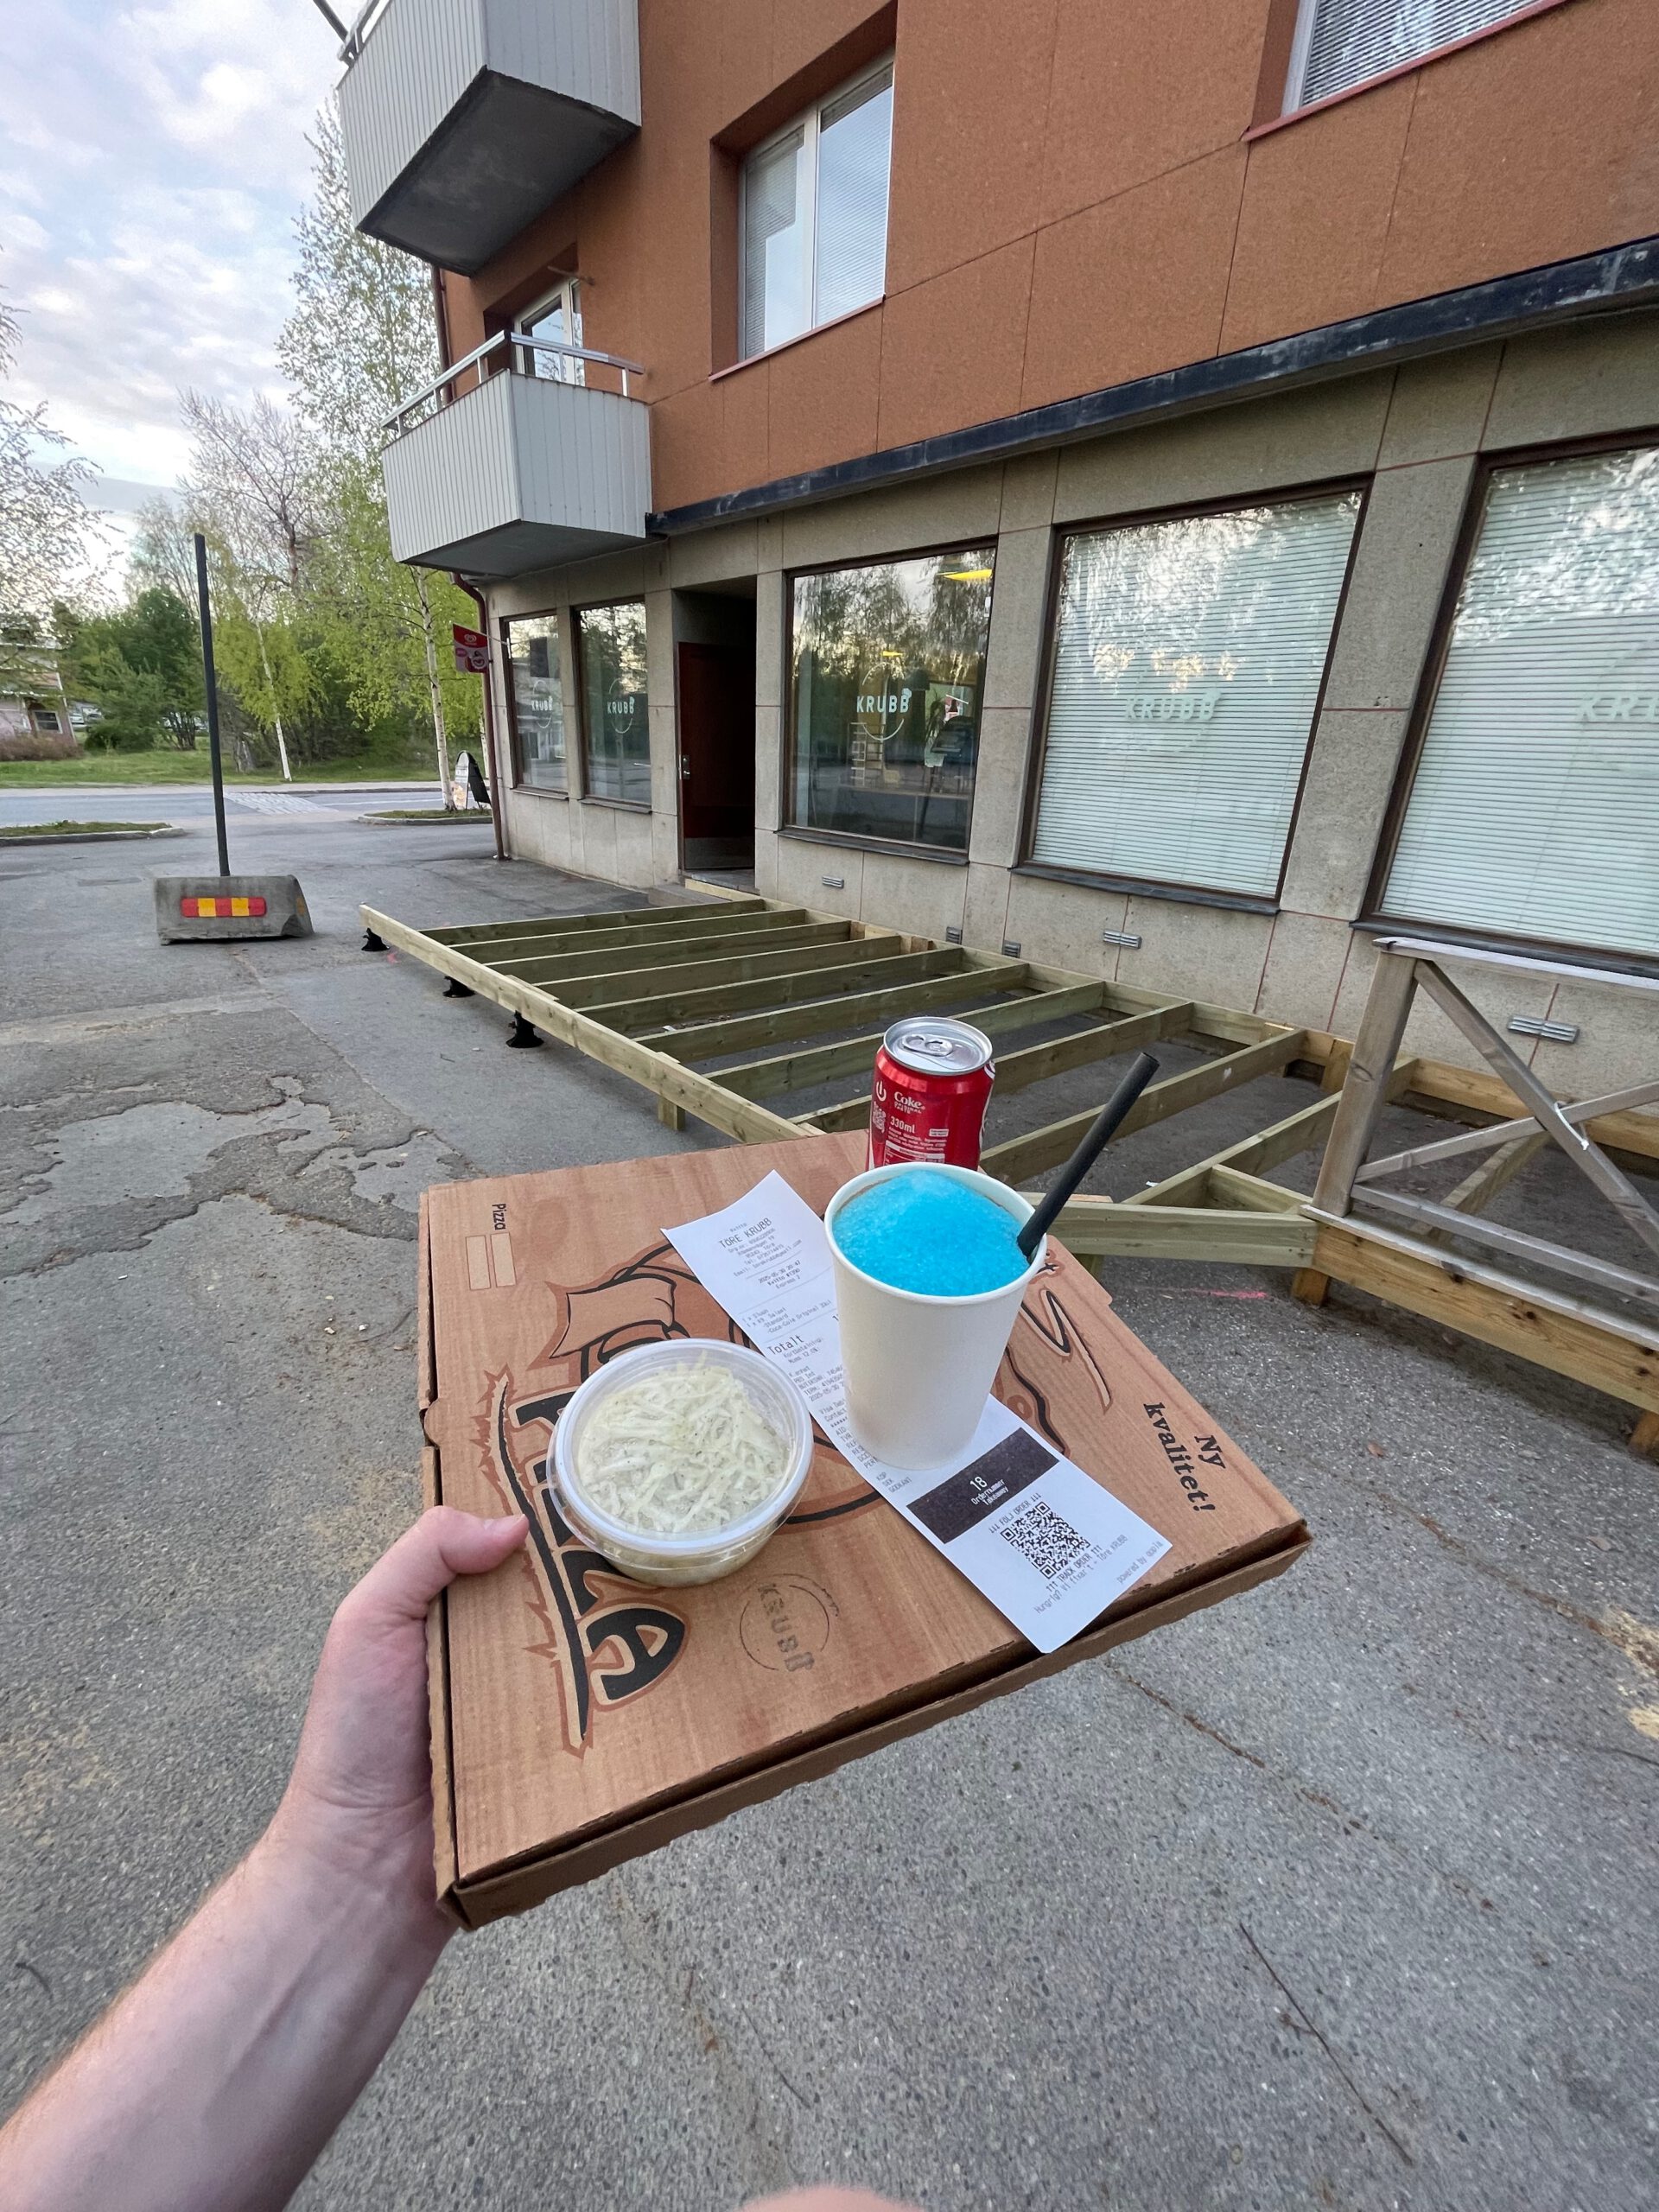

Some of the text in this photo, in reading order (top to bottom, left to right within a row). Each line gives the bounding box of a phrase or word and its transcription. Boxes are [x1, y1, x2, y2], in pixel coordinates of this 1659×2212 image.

[531, 698, 553, 711] KRUBB
[607, 700, 635, 715] KRUBB
[856, 693, 911, 713] KRUBB
[894, 1091, 923, 1109] Coke
[890, 1116, 916, 1134] 330ml
[492, 1203, 507, 1230] Pizza
[743, 1217, 772, 1238] KRUBB
[767, 1335, 804, 1355] Totalt
[1142, 1402, 1216, 1511] kvalitet!
[1193, 1434, 1226, 1469] Ny
[969, 1476, 988, 1491] 18
[970, 1478, 1005, 1505] Ordernummer
[982, 1485, 1009, 1505] Takeaway
[1013, 1500, 1032, 1515] ORDER
[1056, 1553, 1093, 1583] TRACK ORDER
[1116, 1562, 1141, 1585] powered
[1136, 1554, 1147, 1567] by
[1033, 1590, 1063, 1614] Hungrig?
